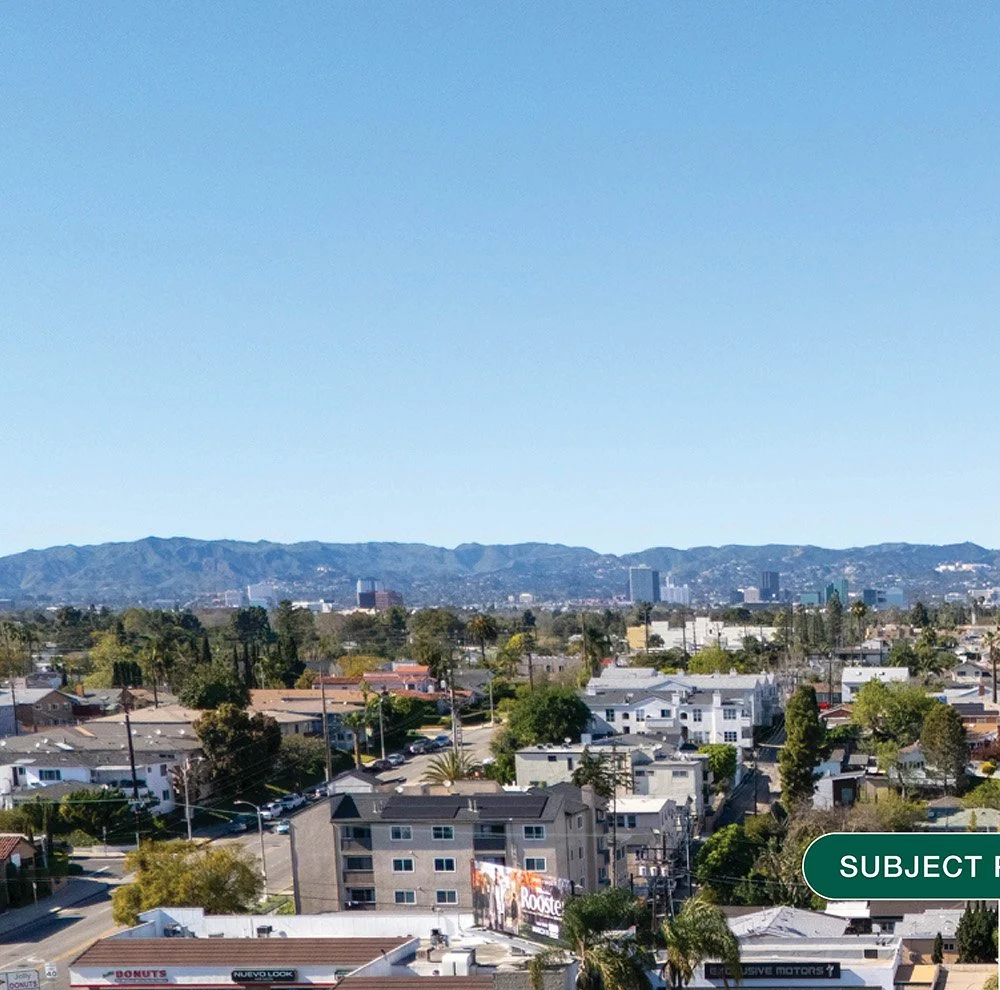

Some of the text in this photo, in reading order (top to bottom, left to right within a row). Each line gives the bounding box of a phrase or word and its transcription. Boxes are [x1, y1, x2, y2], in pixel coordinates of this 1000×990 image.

[115, 969, 168, 978] DONUTS
[233, 970, 293, 978] NUEVO LOOK
[775, 966, 824, 976] MOTORS
